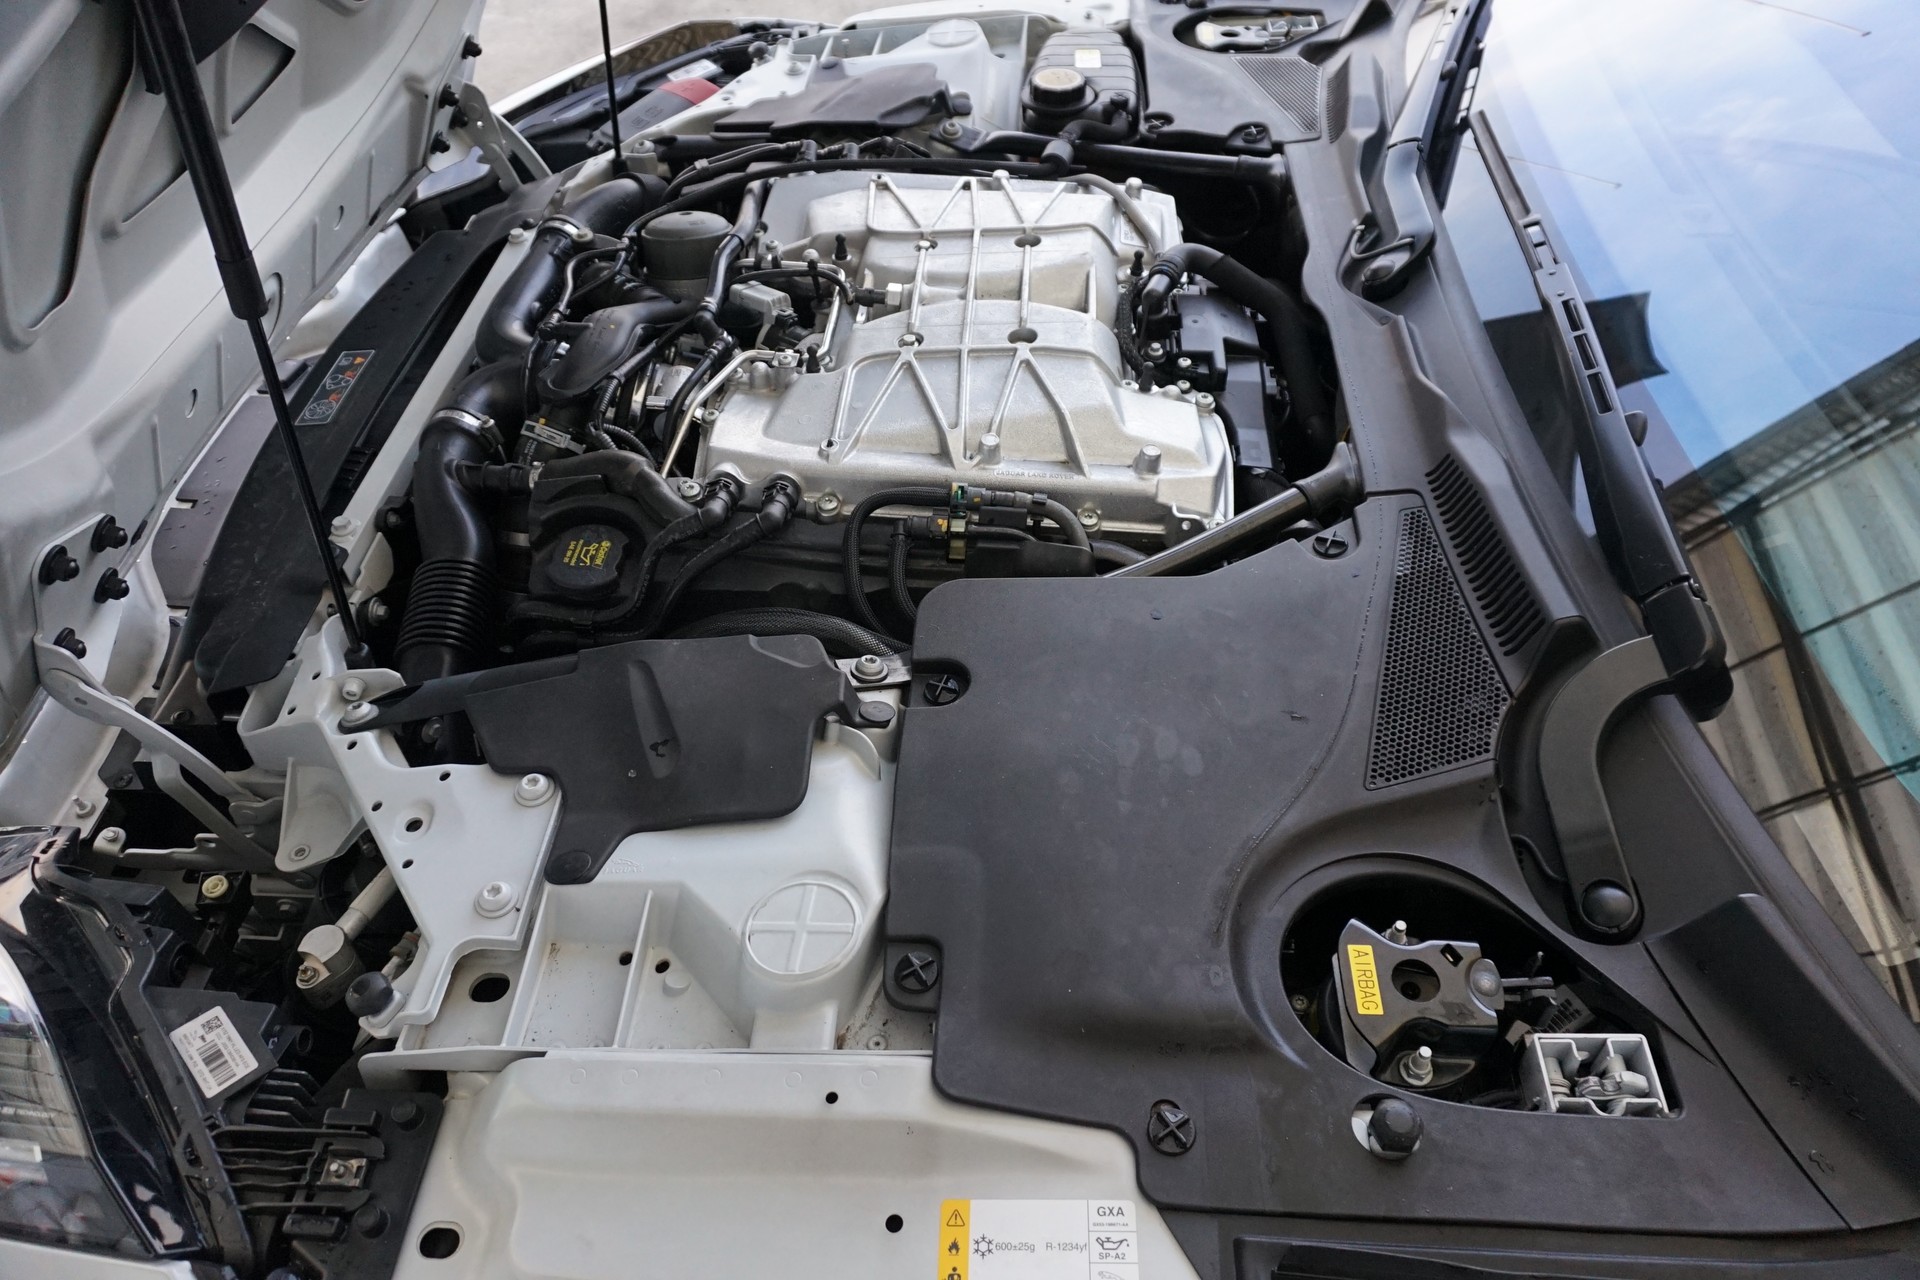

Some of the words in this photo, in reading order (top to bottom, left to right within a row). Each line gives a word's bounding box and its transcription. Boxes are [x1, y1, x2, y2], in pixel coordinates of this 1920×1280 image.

[1352, 948, 1379, 1011] AIRBAG
[1096, 1206, 1125, 1217] GXA
[995, 1242, 1036, 1253] 600±25g
[1045, 1242, 1088, 1253] R-1234yf
[1098, 1252, 1127, 1260] SP-A2
